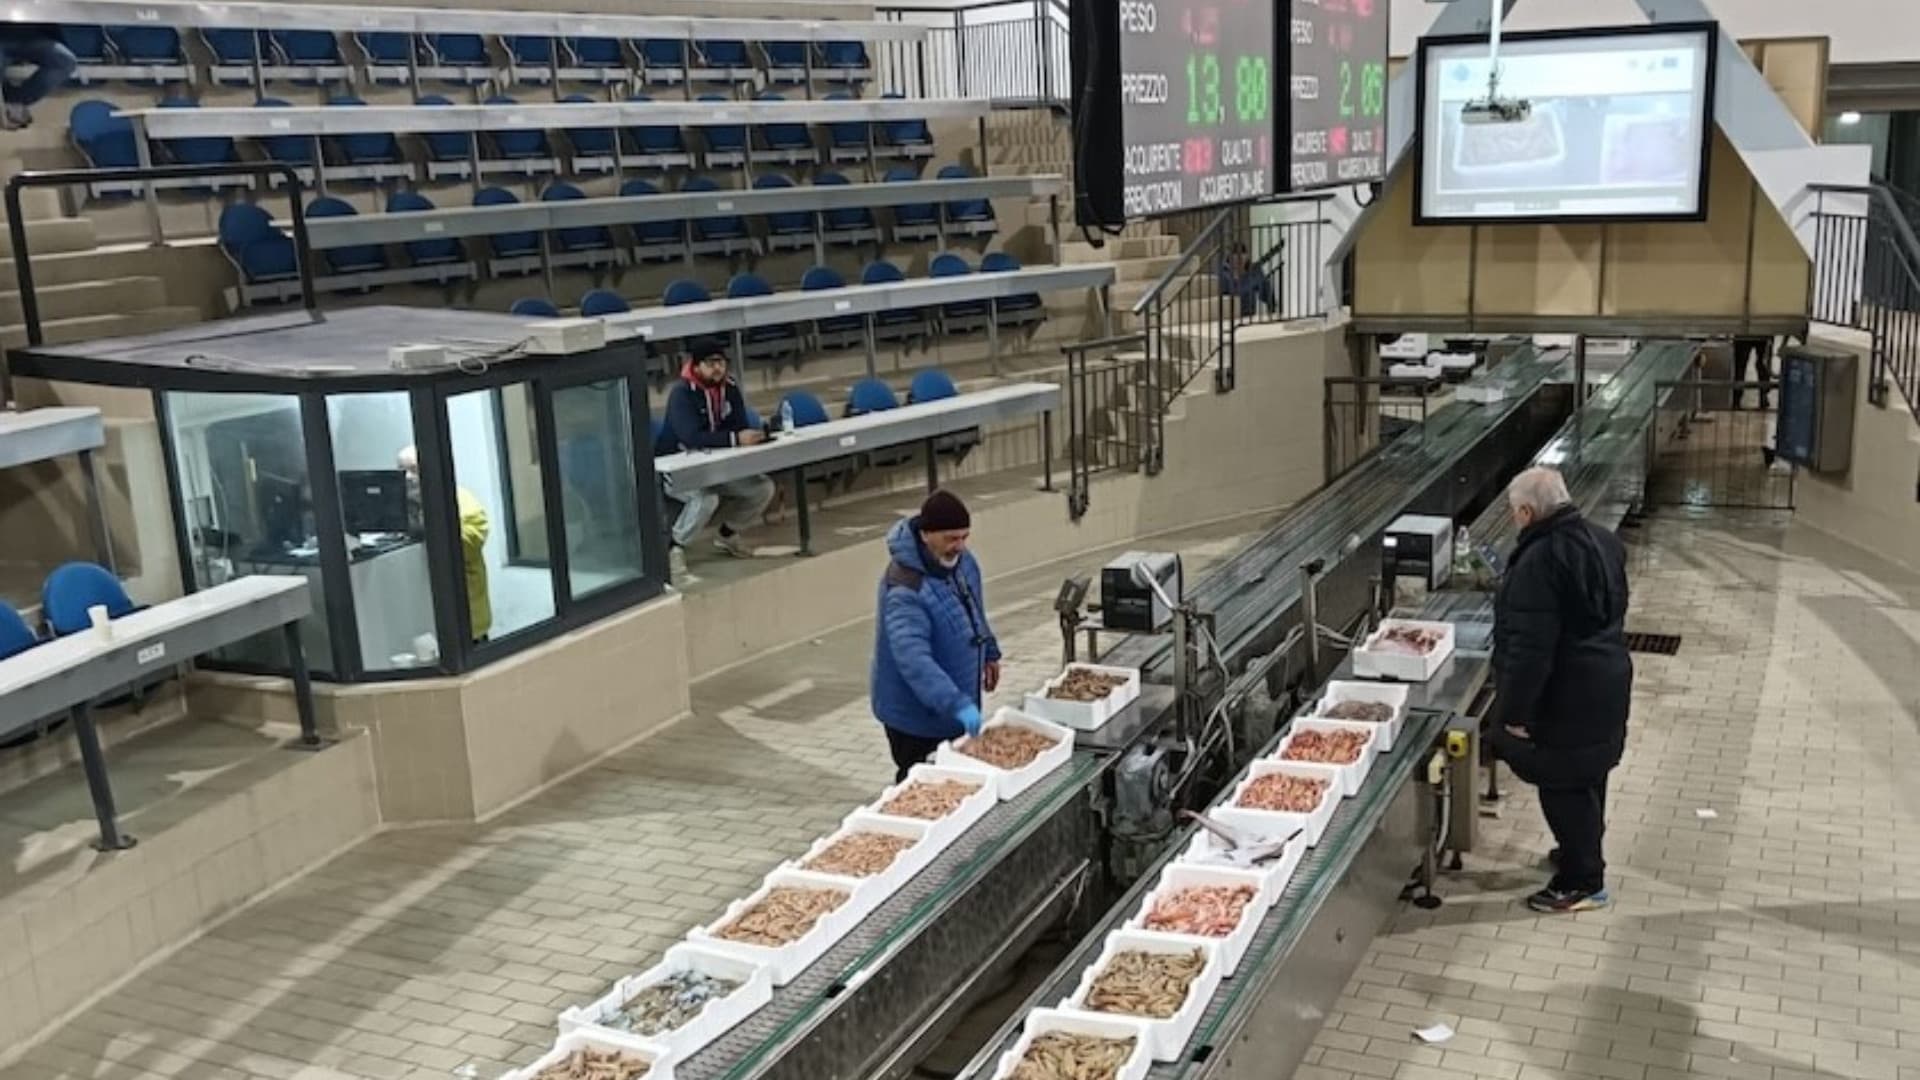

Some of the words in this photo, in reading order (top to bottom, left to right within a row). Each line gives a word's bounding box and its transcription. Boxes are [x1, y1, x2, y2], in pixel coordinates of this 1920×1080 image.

[1119, 1, 1156, 32] PESO
[1121, 74, 1168, 103] PREZZO
[1124, 143, 1181, 175] ACQUIRENTE
